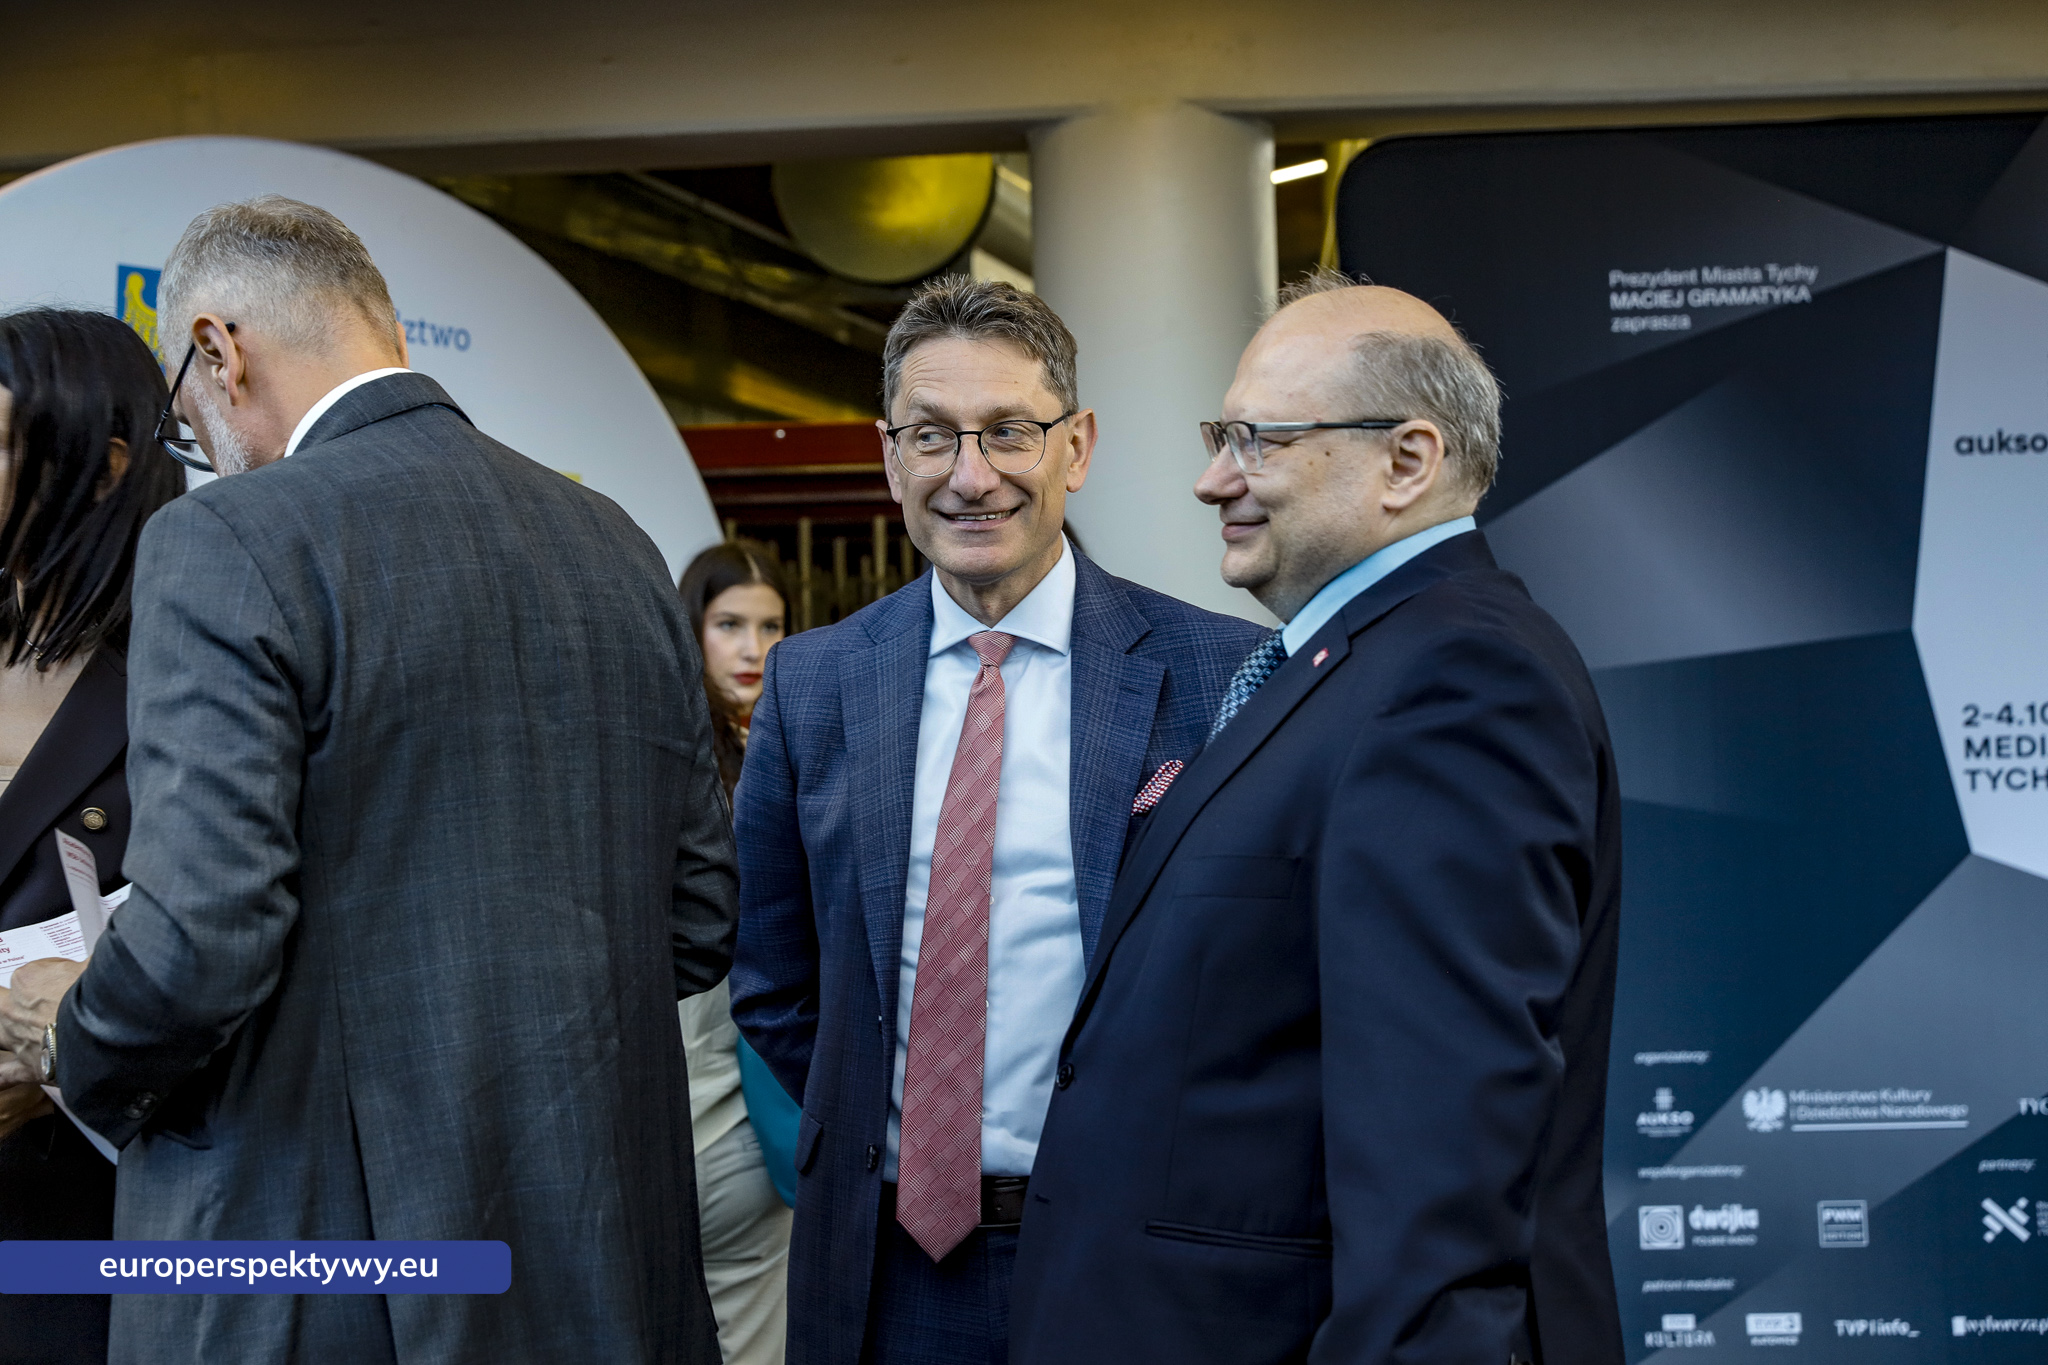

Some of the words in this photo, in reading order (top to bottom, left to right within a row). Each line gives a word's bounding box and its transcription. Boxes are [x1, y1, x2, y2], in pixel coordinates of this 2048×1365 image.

[1609, 268, 1698, 288] Prezydent
[1702, 266, 1763, 284] Miasta
[1765, 263, 1819, 285] Tychy
[1610, 289, 1684, 310] MACIEJ
[1687, 285, 1812, 307] GRAMATYKA
[395, 308, 472, 352] ztwo
[1610, 314, 1692, 334] zaprasza
[1955, 428, 2048, 455] aukso
[1789, 1090, 1879, 1104] Ministerstwo
[1880, 1087, 1932, 1103] Kultury
[1636, 1111, 1695, 1126] AUKSO
[1797, 1106, 1879, 1120] Dziedzictwa
[1880, 1104, 1969, 1119] Narodowego
[1645, 1331, 1716, 1348] KULTURA
